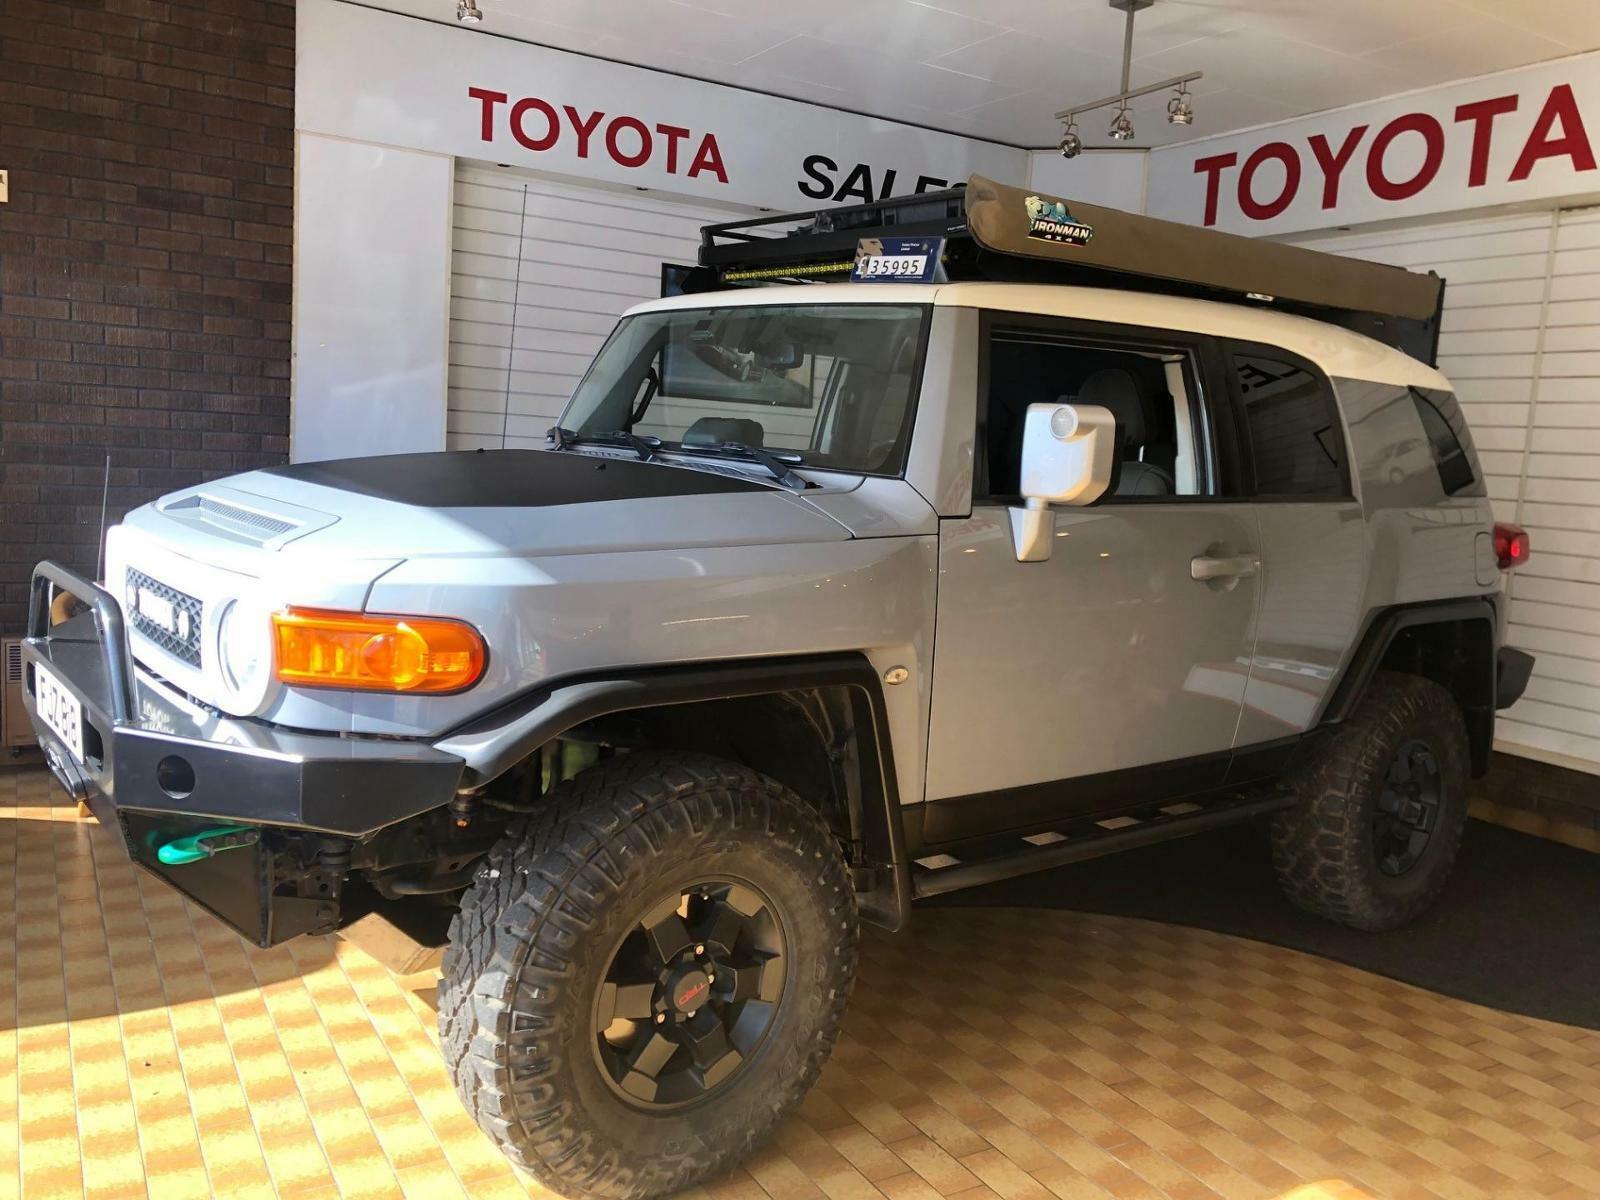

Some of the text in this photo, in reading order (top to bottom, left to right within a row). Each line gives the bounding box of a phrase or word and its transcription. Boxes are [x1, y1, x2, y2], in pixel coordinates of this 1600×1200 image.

[468, 86, 730, 184] TOYOTA
[1193, 83, 1598, 227] TOYOTA
[1034, 220, 1090, 239] IRONMAN
